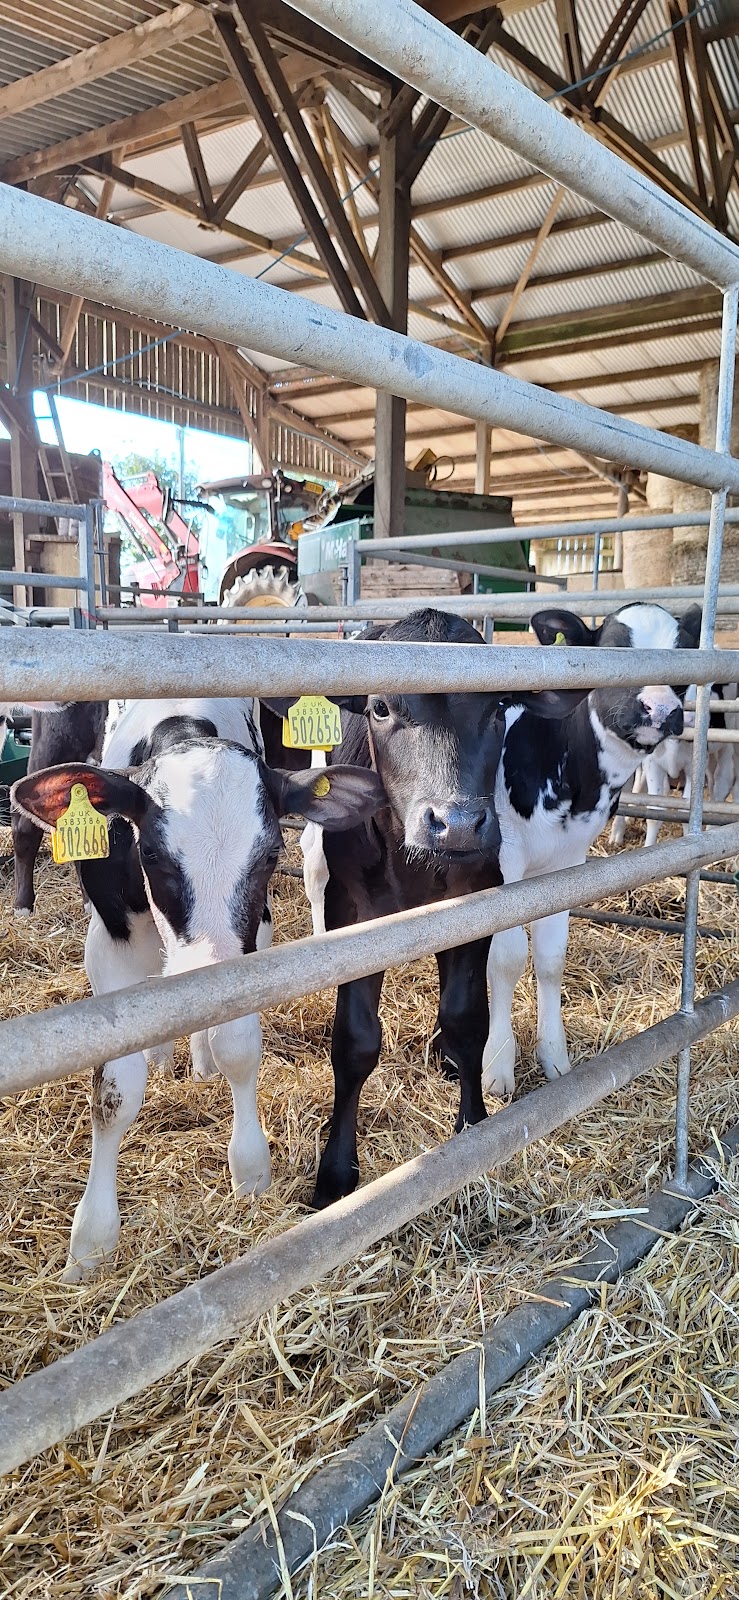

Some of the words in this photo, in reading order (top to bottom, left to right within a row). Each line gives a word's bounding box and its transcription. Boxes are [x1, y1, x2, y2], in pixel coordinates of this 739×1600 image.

[296, 707, 333, 716] 383386
[292, 714, 341, 745] 502656
[63, 817, 100, 826] 383386
[60, 825, 108, 857] 302668
